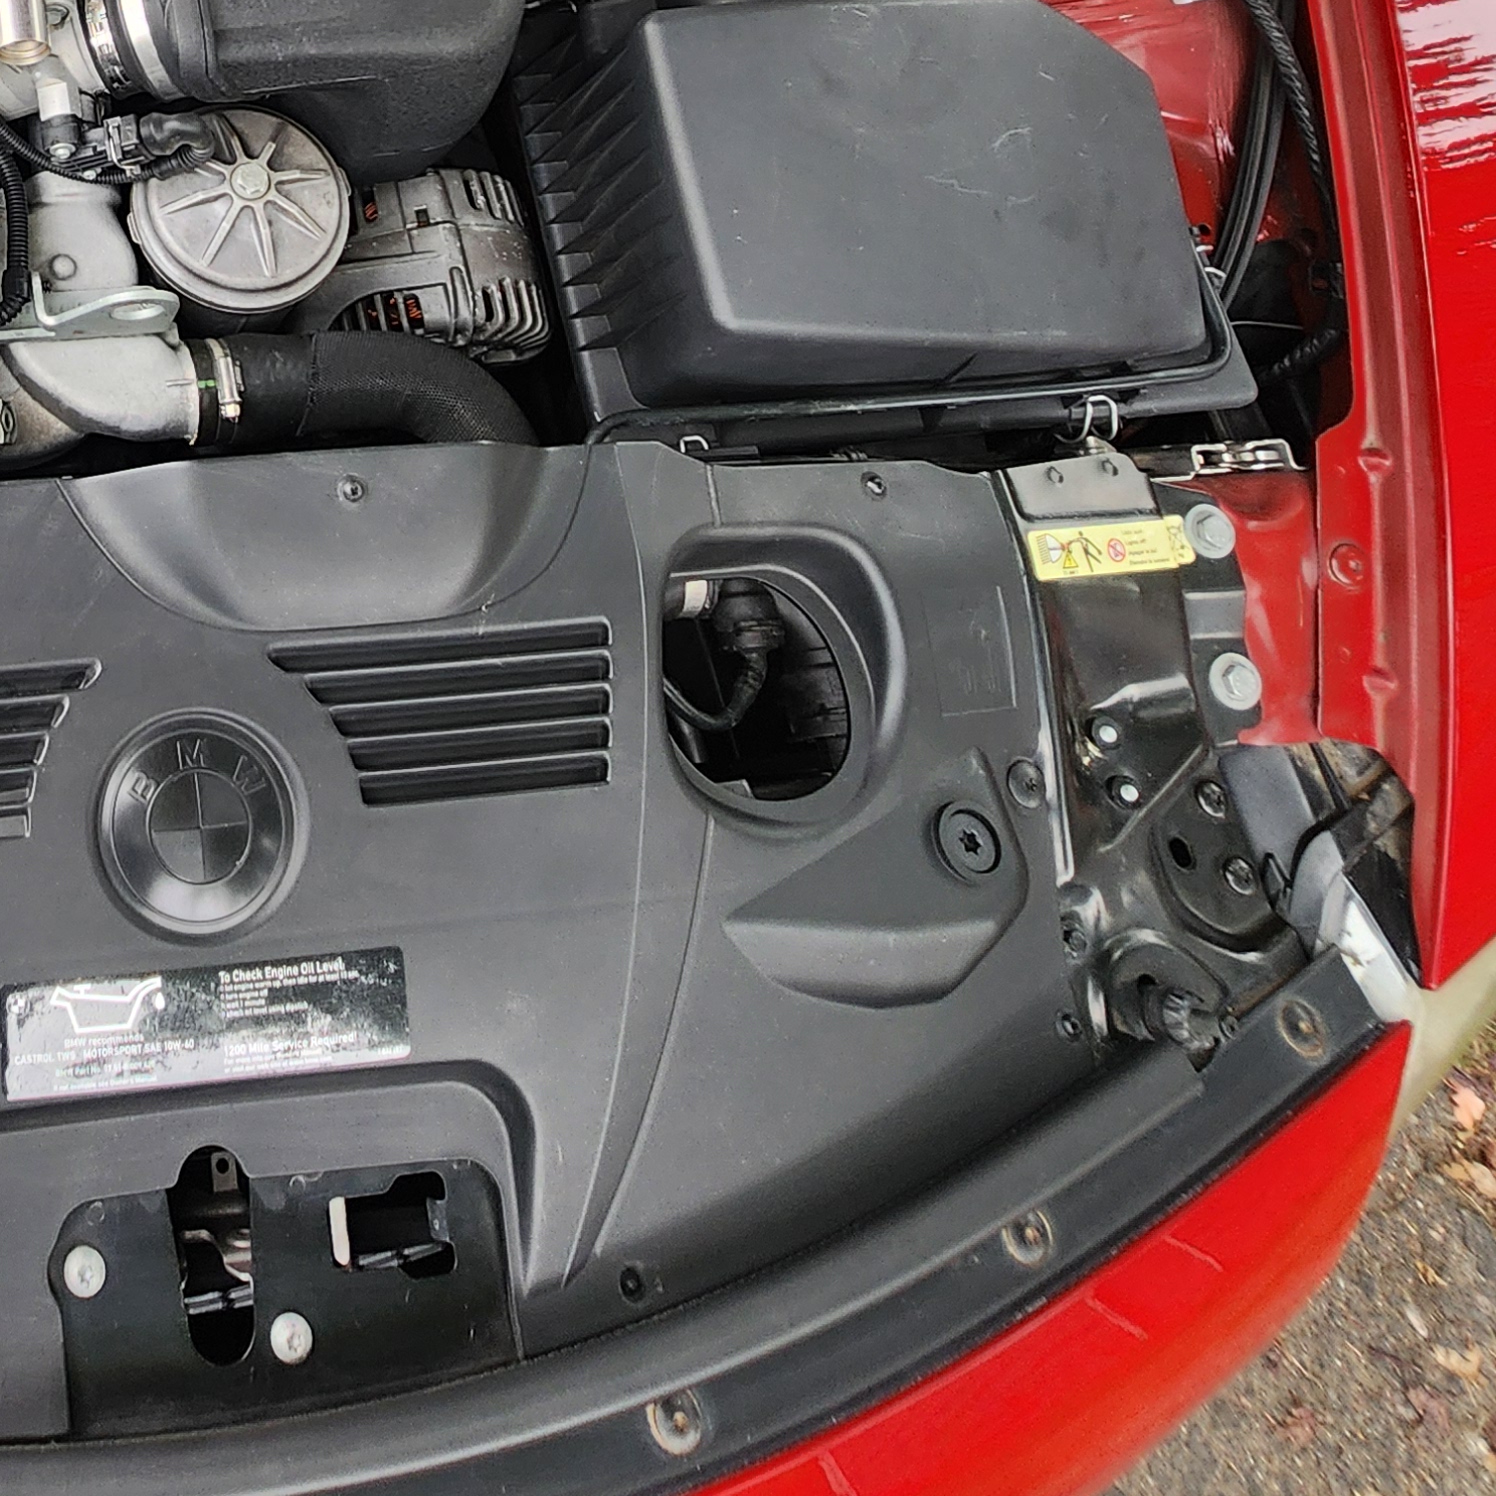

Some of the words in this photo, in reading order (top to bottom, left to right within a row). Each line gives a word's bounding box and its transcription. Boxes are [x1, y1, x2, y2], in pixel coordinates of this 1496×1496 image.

[125, 737, 267, 805] BMW
[218, 970, 230, 983] To
[232, 967, 263, 982] Check
[264, 964, 299, 980] Engine
[300, 961, 315, 975] Oil
[83, 1041, 143, 1062] MOTORSPORT
[144, 1040, 162, 1053] SAE
[163, 1038, 195, 1052] 10W-60
[223, 1044, 247, 1058] 1200
[248, 1042, 270, 1055] Mile
[271, 1038, 308, 1054] Service
